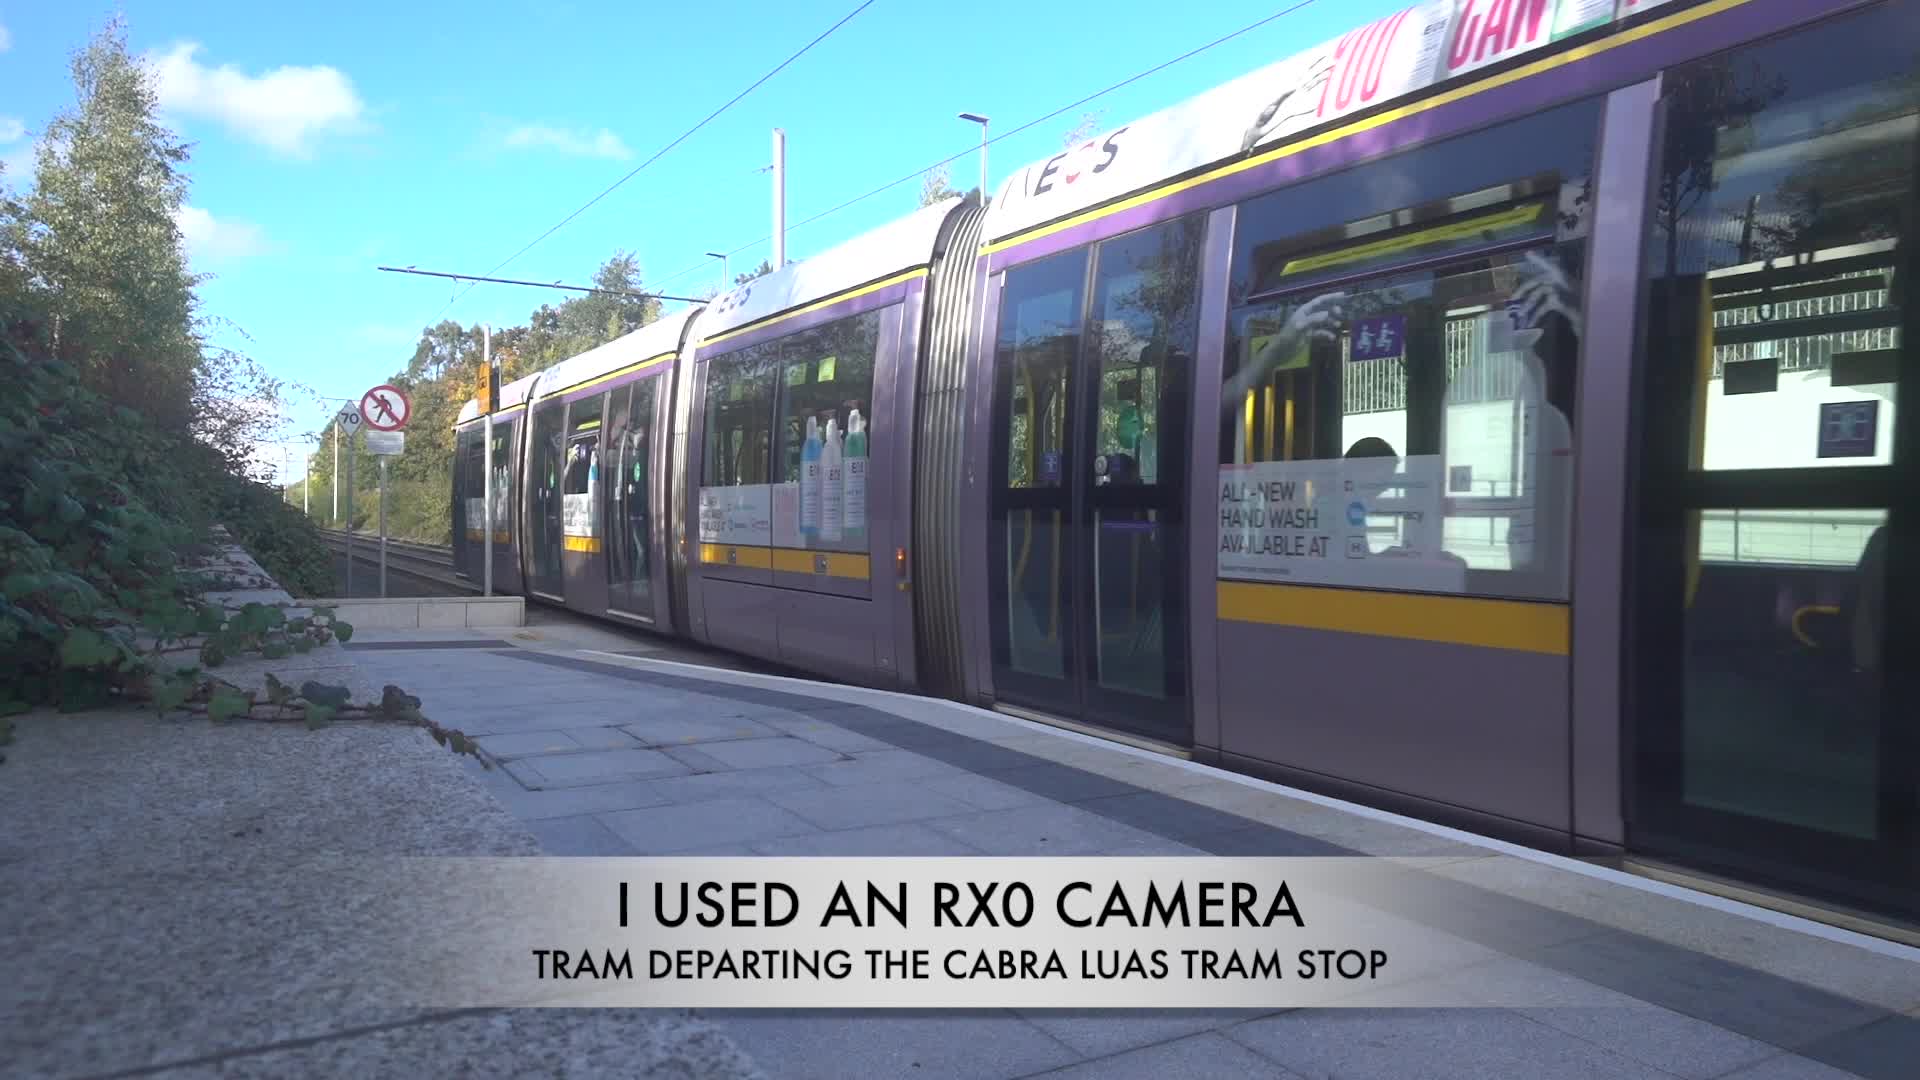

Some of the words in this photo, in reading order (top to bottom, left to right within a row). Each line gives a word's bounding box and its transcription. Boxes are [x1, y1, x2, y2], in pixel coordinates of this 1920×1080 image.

[341, 412, 359, 424] 70
[1221, 481, 1296, 502] ALL-NEW
[1221, 508, 1265, 528] HAND
[1269, 508, 1319, 529] WASH
[1220, 535, 1305, 556] AVAILABLE
[1308, 536, 1330, 558] AT
